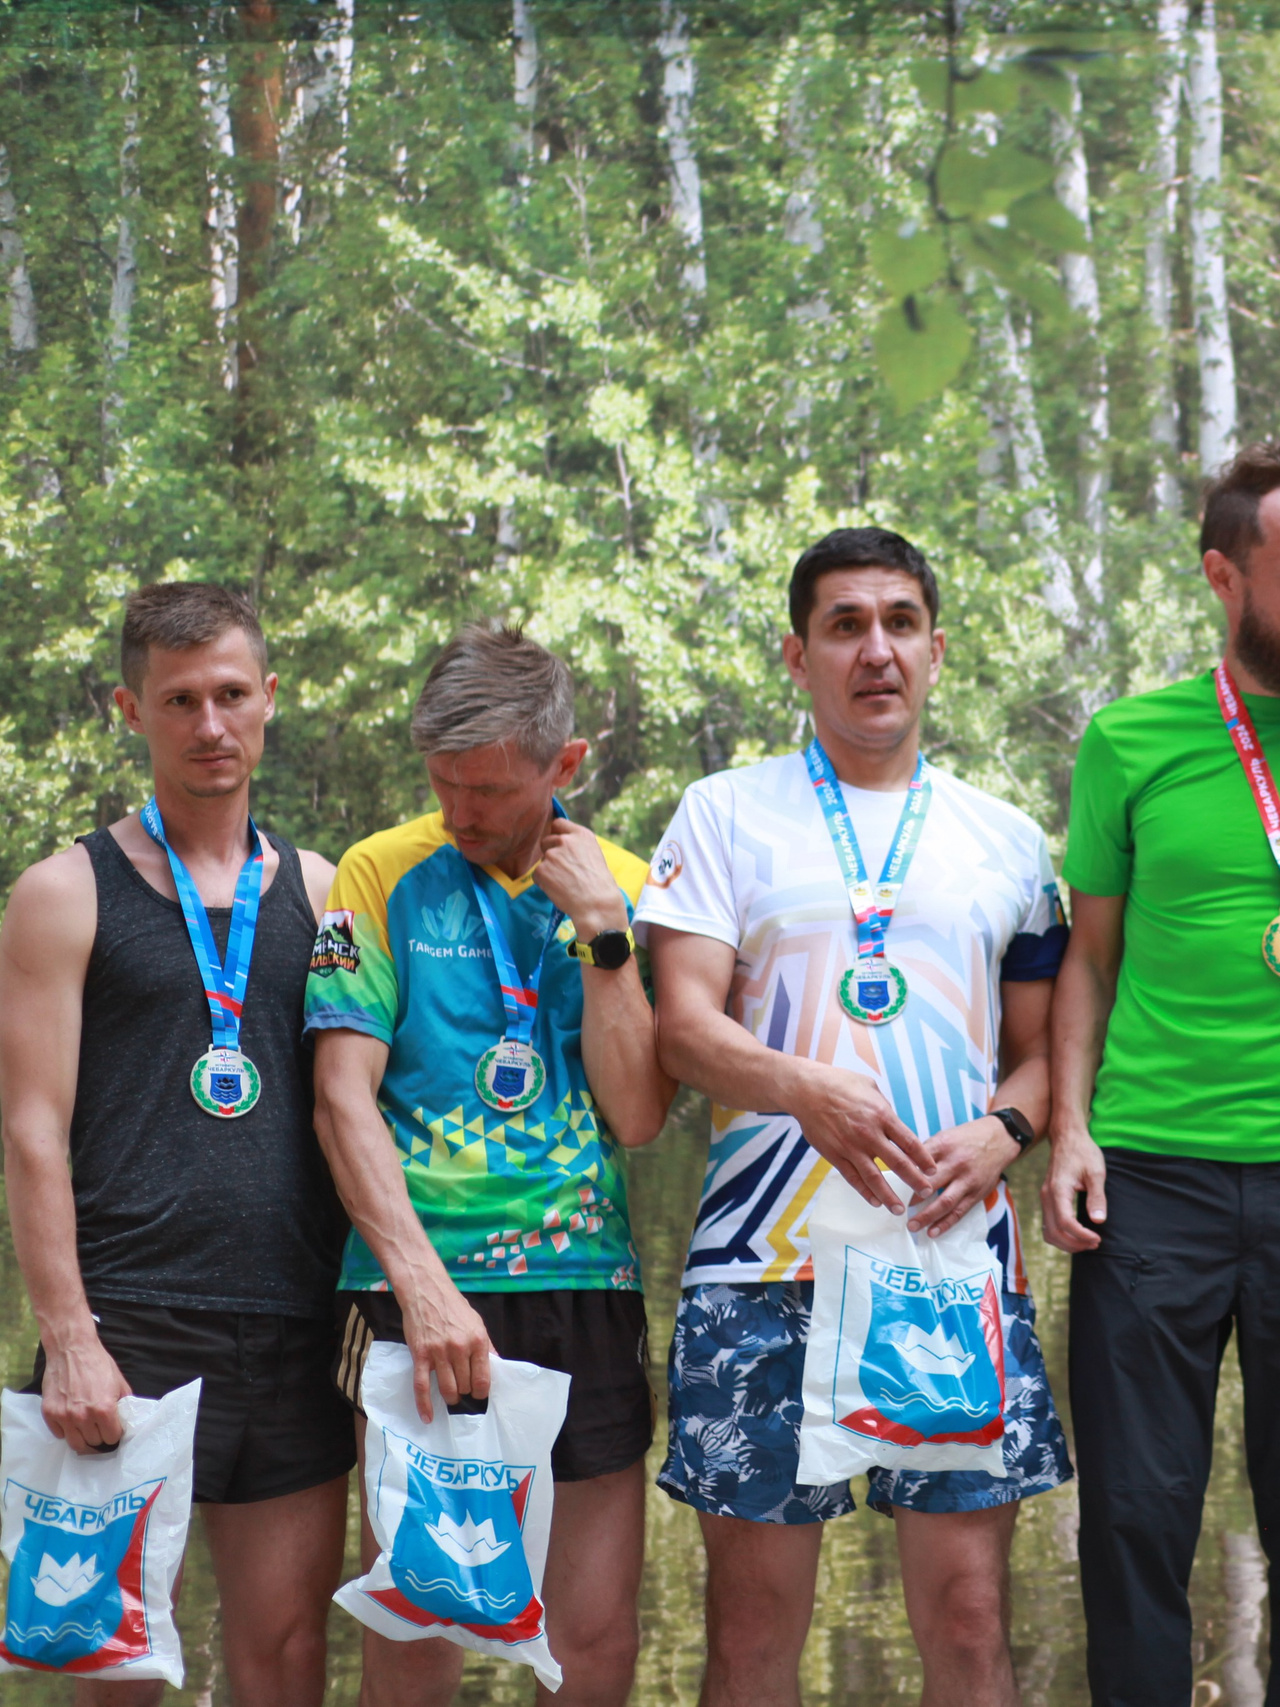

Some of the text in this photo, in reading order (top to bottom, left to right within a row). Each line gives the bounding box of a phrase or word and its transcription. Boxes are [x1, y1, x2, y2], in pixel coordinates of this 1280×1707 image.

[1236, 723, 1280, 830] ЧЕБАРКУЛЬ 2024
[822, 781, 860, 877] ЧЕБАРКУЛЬ 2024
[886, 818, 916, 879] ЧЕБАРКУЛЬ
[909, 790, 924, 815] 2024
[311, 939, 359, 960] МЕНСК
[458, 944, 492, 958] GAME
[406, 1443, 520, 1492] ЧЕБАРКУЬ
[24, 1493, 147, 1531] ЧБАРКЛЬ
